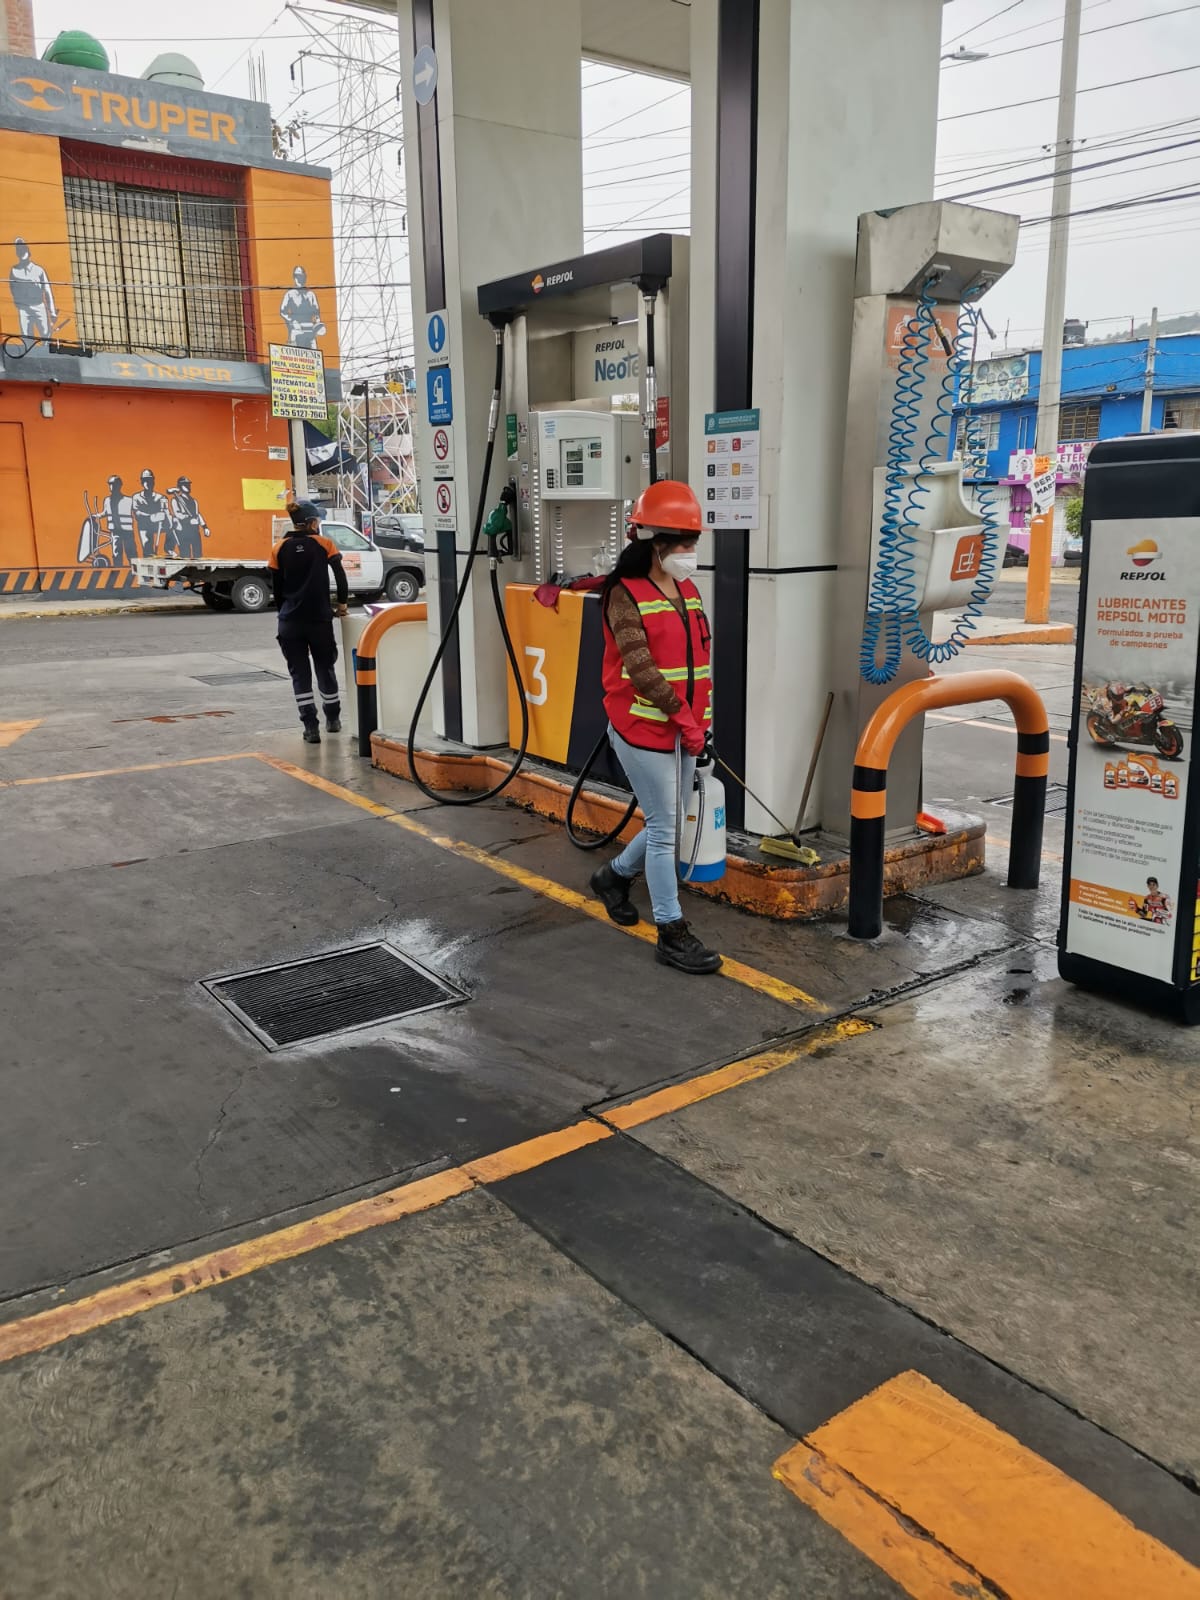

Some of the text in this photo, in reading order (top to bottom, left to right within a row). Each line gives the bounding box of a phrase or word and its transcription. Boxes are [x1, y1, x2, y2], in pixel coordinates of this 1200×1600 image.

[72, 84, 238, 145] TRUPER
[547, 270, 574, 287] REPSOL
[595, 339, 625, 353] REPSOL
[142, 363, 233, 383] TRUPER
[1120, 571, 1167, 581] REPSOL
[1097, 597, 1187, 610] LUBRICANTES
[1097, 610, 1186, 625] REPSOL MOTO
[1097, 628, 1144, 638] Formulados
[1153, 631, 1184, 640] prueba
[1109, 639, 1169, 649] de campeones
[525, 647, 548, 706] 3
